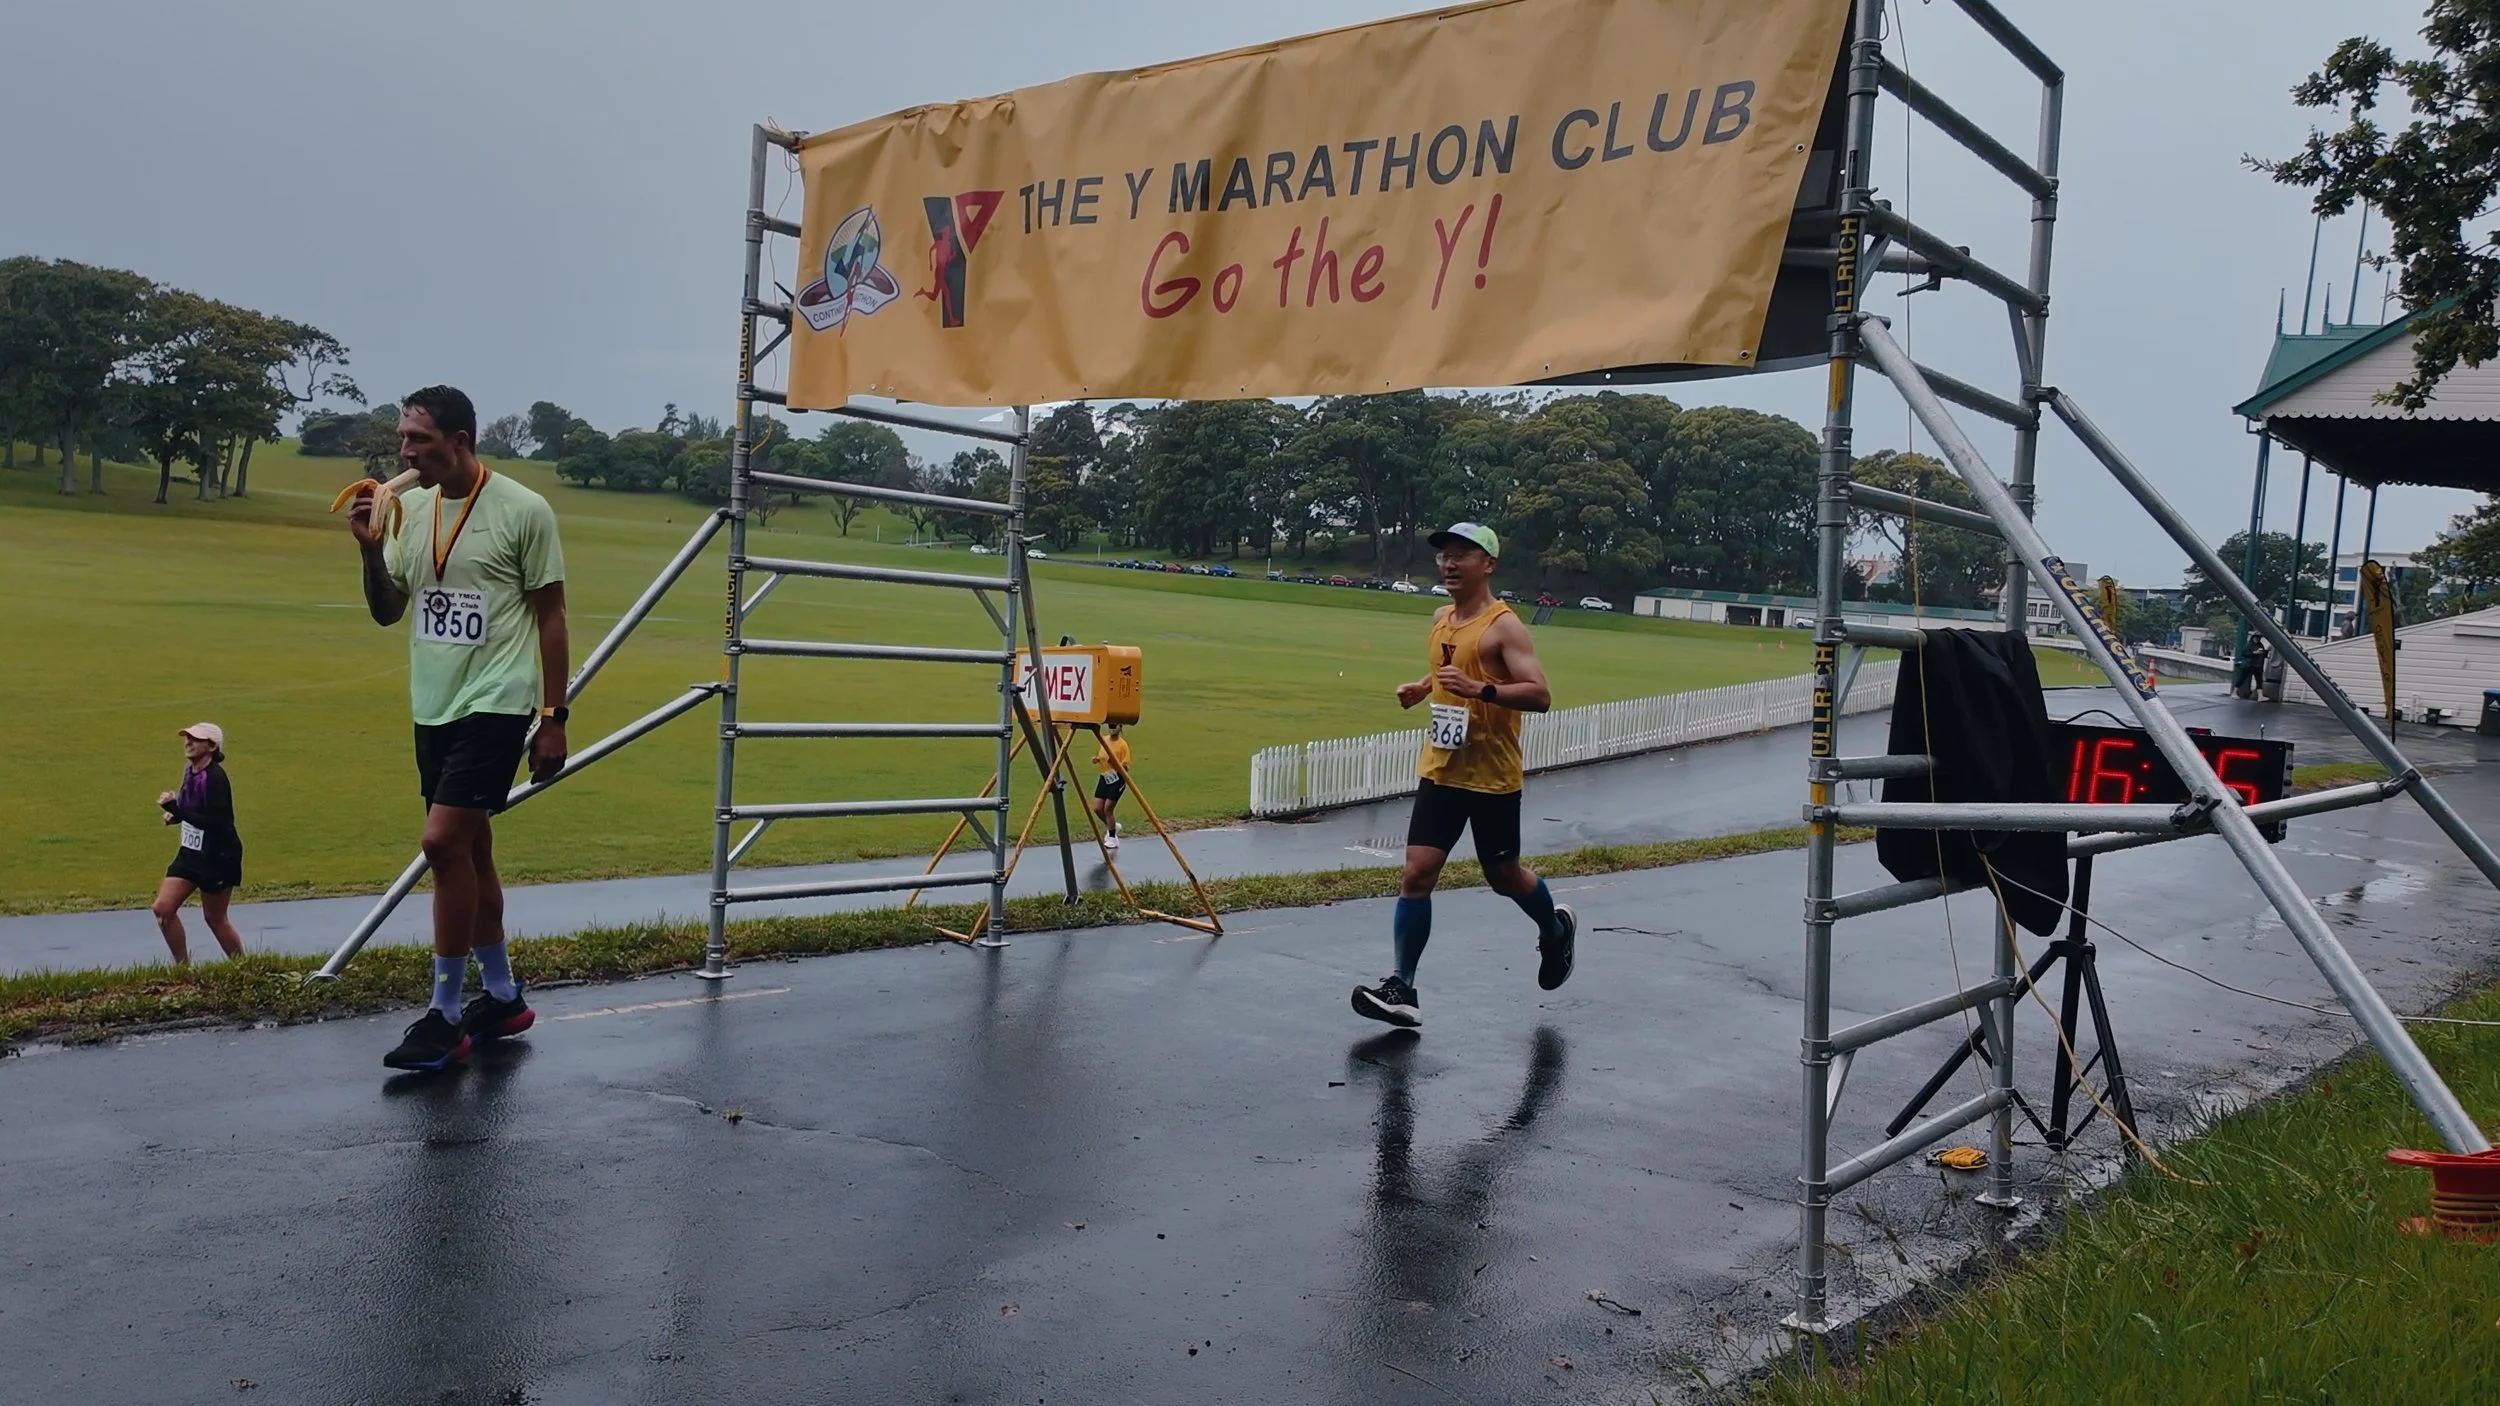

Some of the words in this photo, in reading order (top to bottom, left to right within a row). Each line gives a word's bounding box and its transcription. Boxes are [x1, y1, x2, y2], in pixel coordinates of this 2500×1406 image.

[1019, 176, 1104, 235] THE
[1124, 167, 1155, 221] Y
[1167, 114, 1520, 214] MARATHON
[1551, 79, 1756, 171] CLUB
[1141, 230, 1244, 319] Go
[1272, 215, 1386, 308] the
[1431, 192, 1503, 310] Y!
[1834, 217, 1858, 313] LLRICH
[423, 608, 483, 640] 1850
[458, 592, 481, 601] YMCA
[460, 602, 479, 610] Club
[1024, 665, 1087, 702] TMEX
[1812, 646, 1834, 755] ULLRCH
